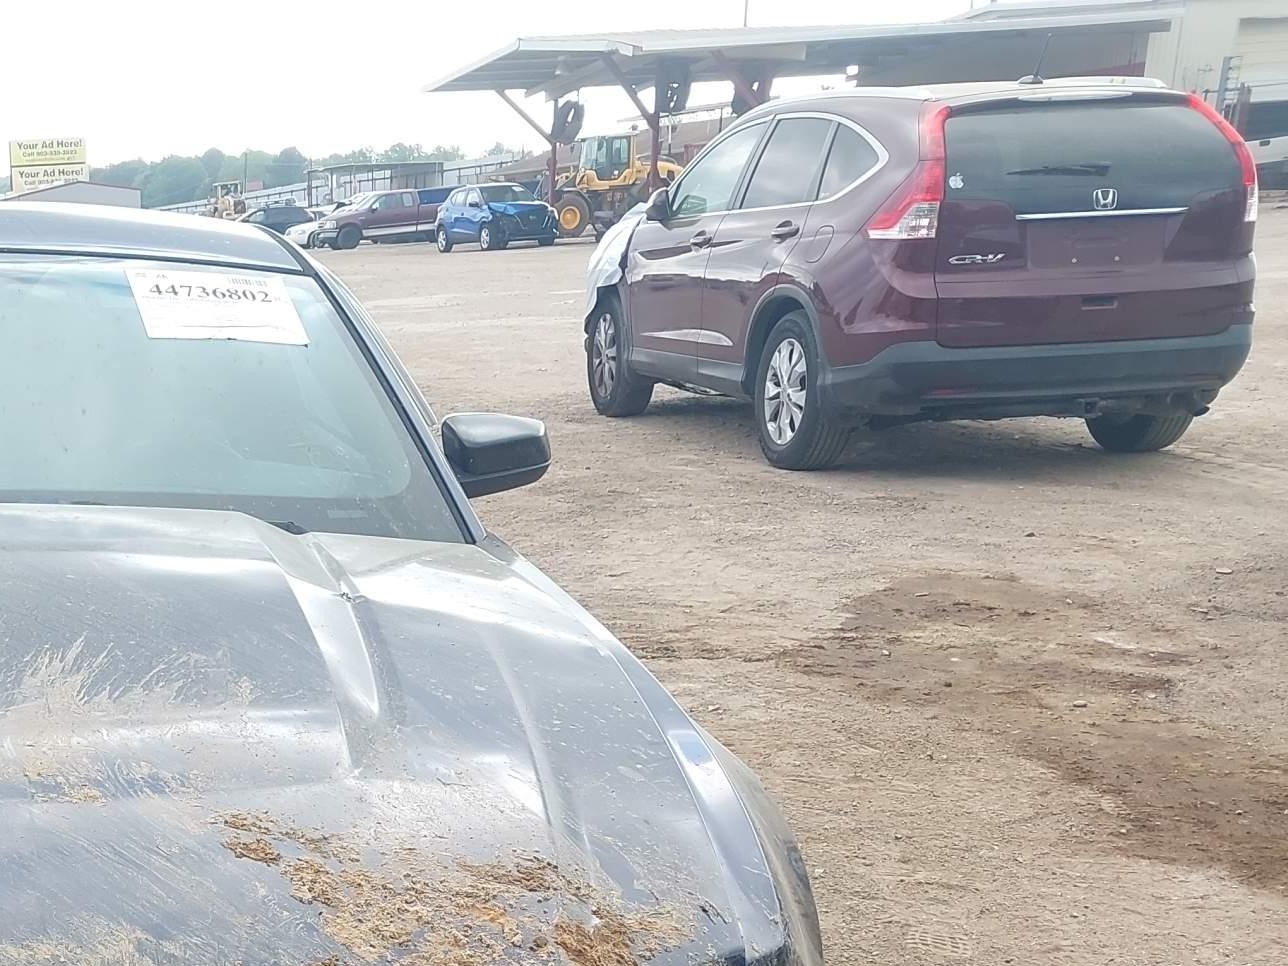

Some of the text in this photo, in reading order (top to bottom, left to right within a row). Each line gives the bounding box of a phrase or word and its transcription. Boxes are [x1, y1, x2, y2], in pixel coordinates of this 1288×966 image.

[17, 140, 82, 150] Your Ad Here!
[19, 168, 83, 178] Your Ad Here!
[148, 283, 273, 303] 44736802
